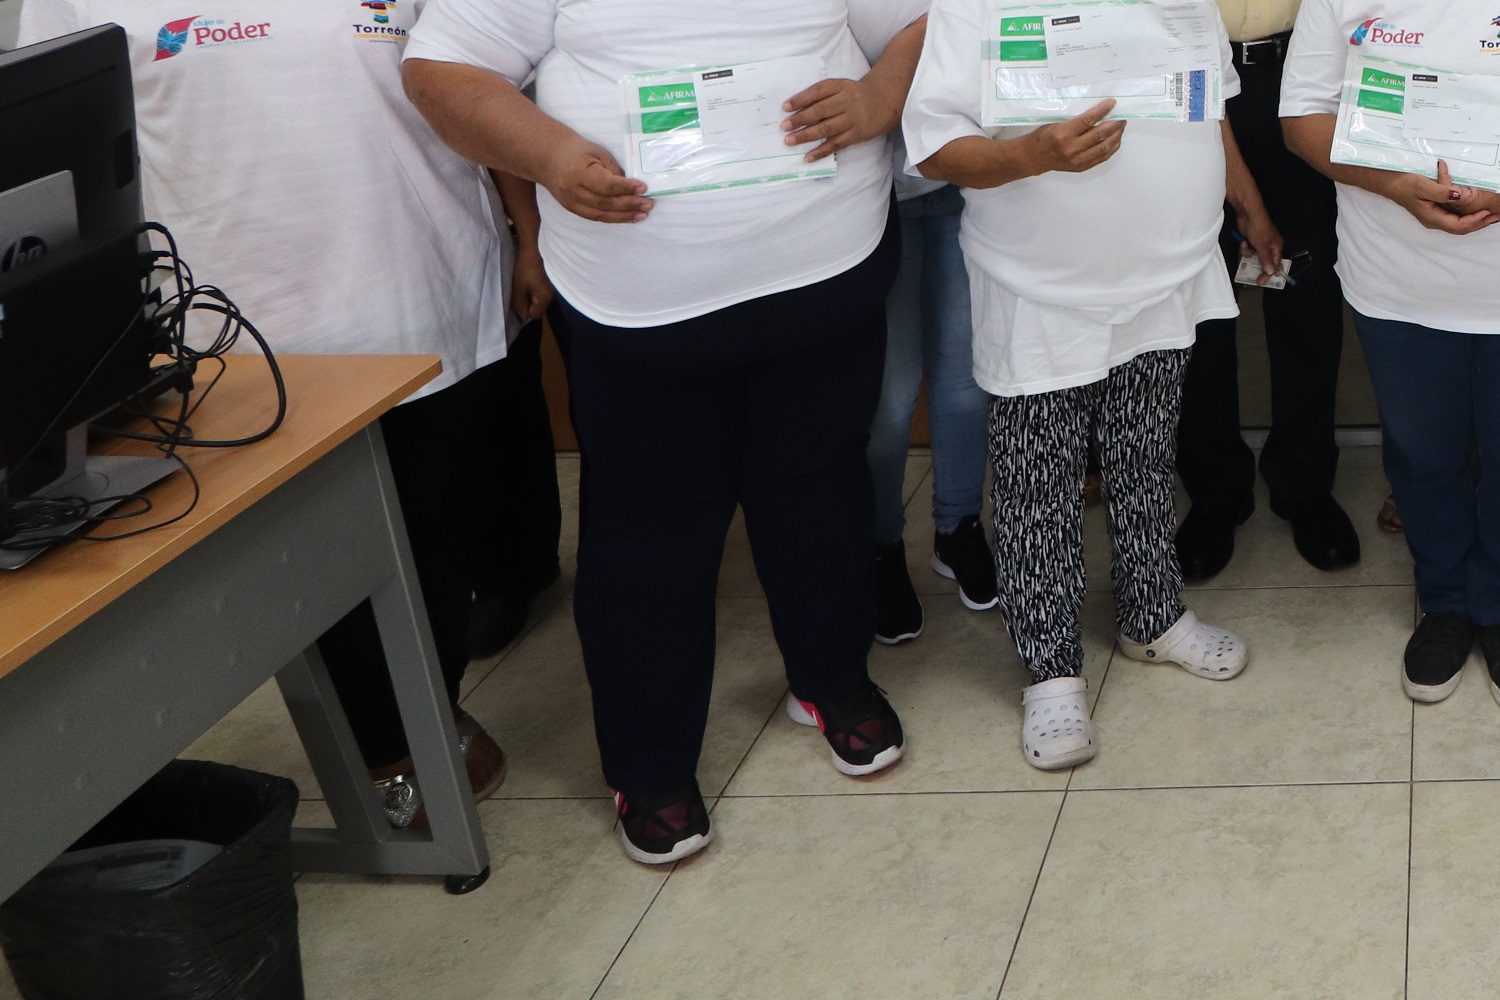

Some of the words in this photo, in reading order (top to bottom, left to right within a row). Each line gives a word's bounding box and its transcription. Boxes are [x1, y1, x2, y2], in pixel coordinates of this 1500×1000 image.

[193, 22, 270, 45] Poder
[353, 24, 406, 36] Torreón
[1370, 28, 1424, 44] Poder
